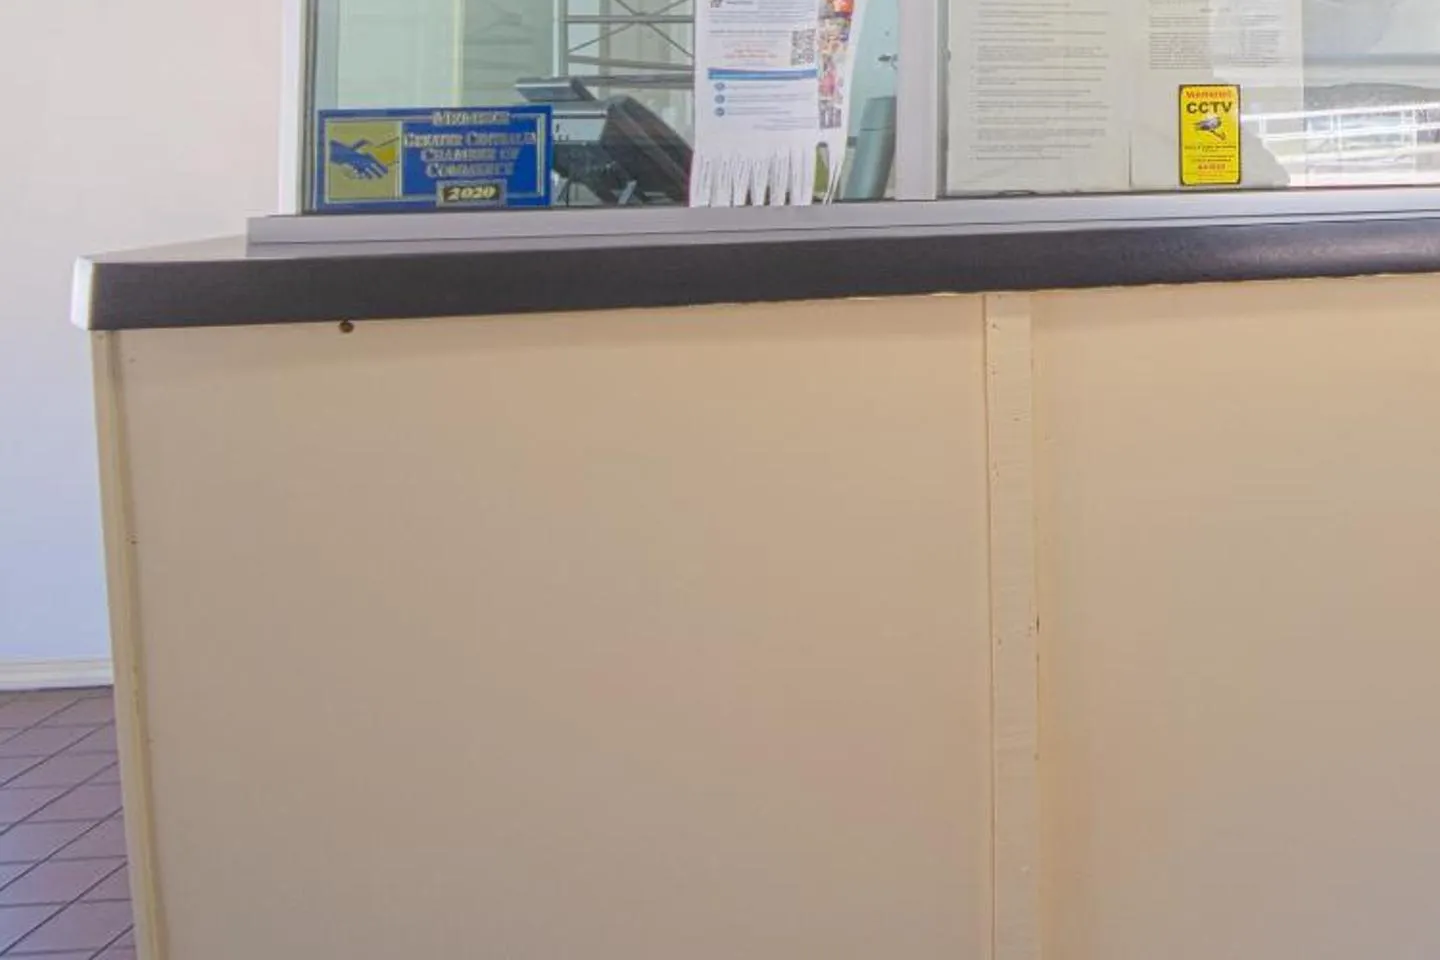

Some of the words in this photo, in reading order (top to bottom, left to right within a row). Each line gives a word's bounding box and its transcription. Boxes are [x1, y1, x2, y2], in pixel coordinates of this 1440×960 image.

[1186, 101, 1232, 114] CCTV
[403, 132, 464, 148] GREATER
[421, 148, 497, 161] CHAMBER
[499, 147, 521, 160] OF
[425, 162, 515, 178] COMMERCE
[447, 186, 497, 200] 2020
